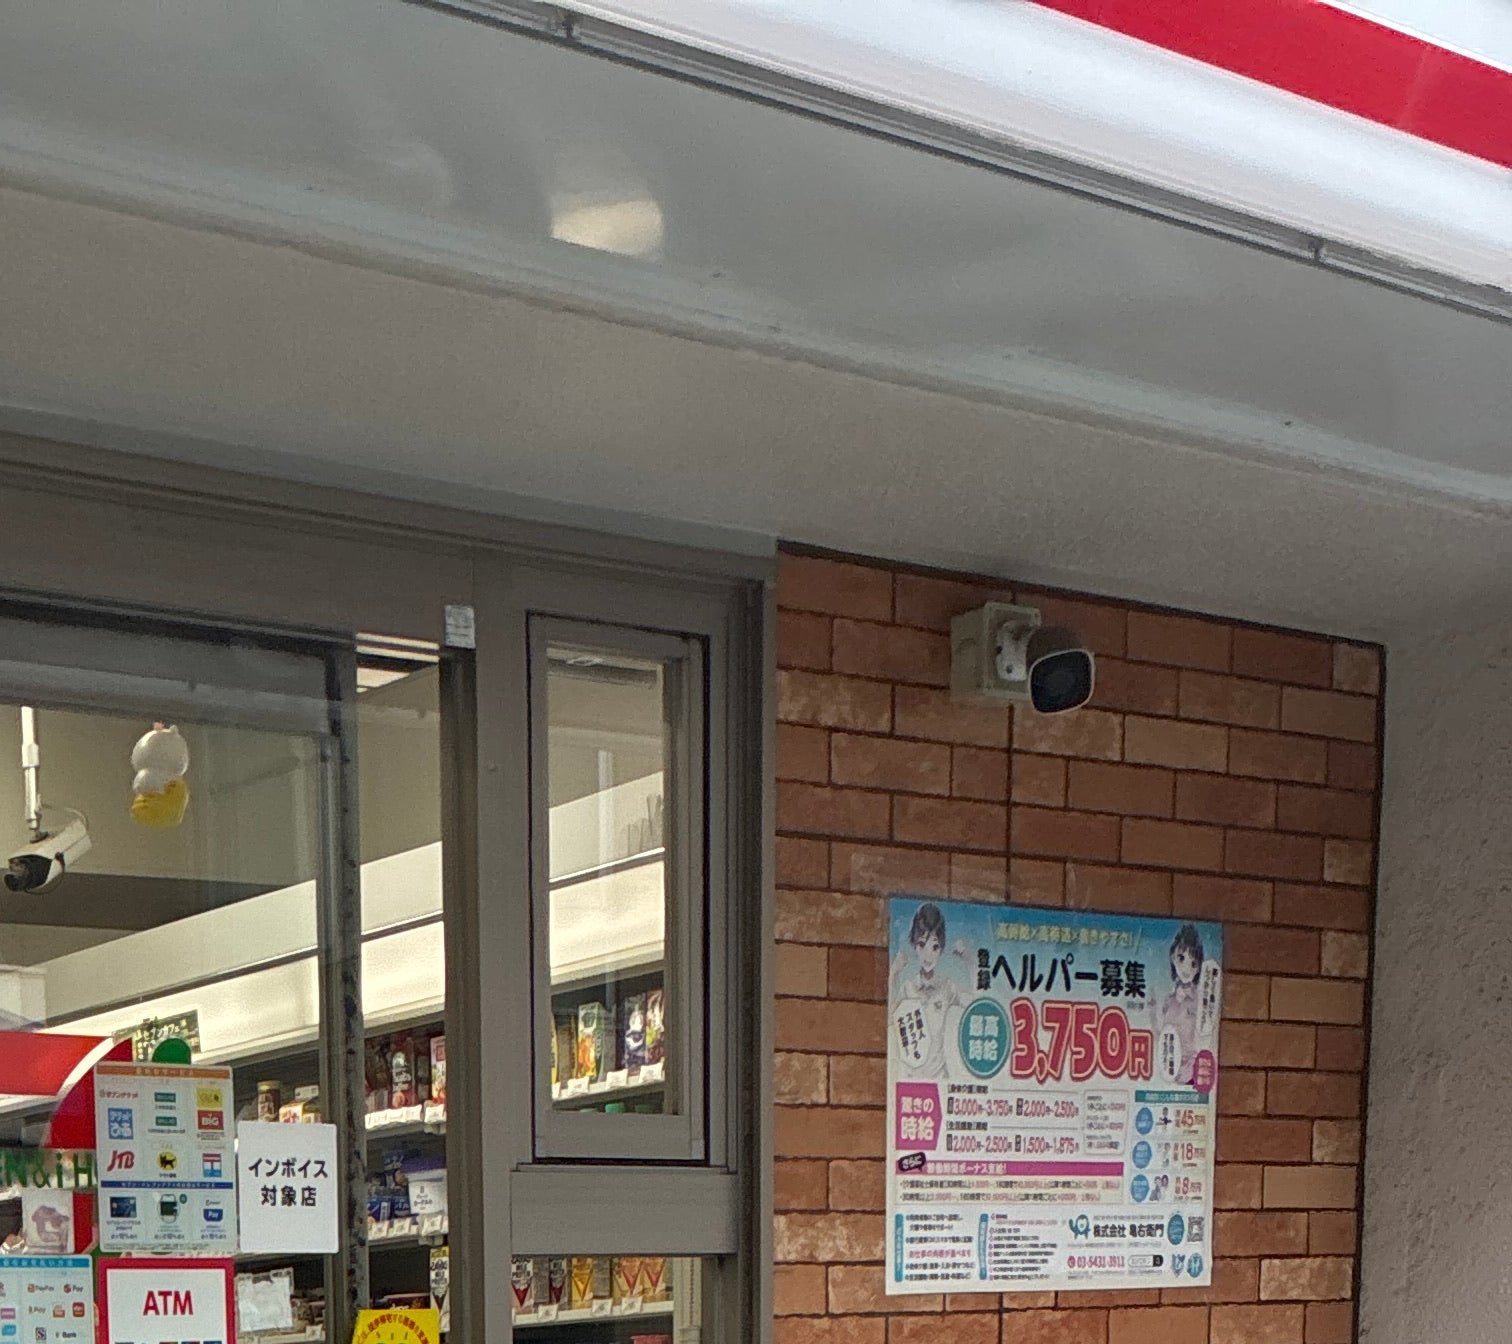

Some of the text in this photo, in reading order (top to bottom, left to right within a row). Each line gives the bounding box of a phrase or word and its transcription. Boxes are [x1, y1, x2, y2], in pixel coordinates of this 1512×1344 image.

[991, 952, 1147, 999] ヘルパー募集
[1010, 997, 1153, 1084] 3,750円
[900, 1116, 935, 1141] 時給
[106, 1149, 135, 1172] JTB
[248, 1157, 329, 1180] インボイス
[261, 1185, 318, 1208] 対象店
[1093, 1223, 1126, 1239] 株式会社
[142, 1290, 194, 1316] ATM
